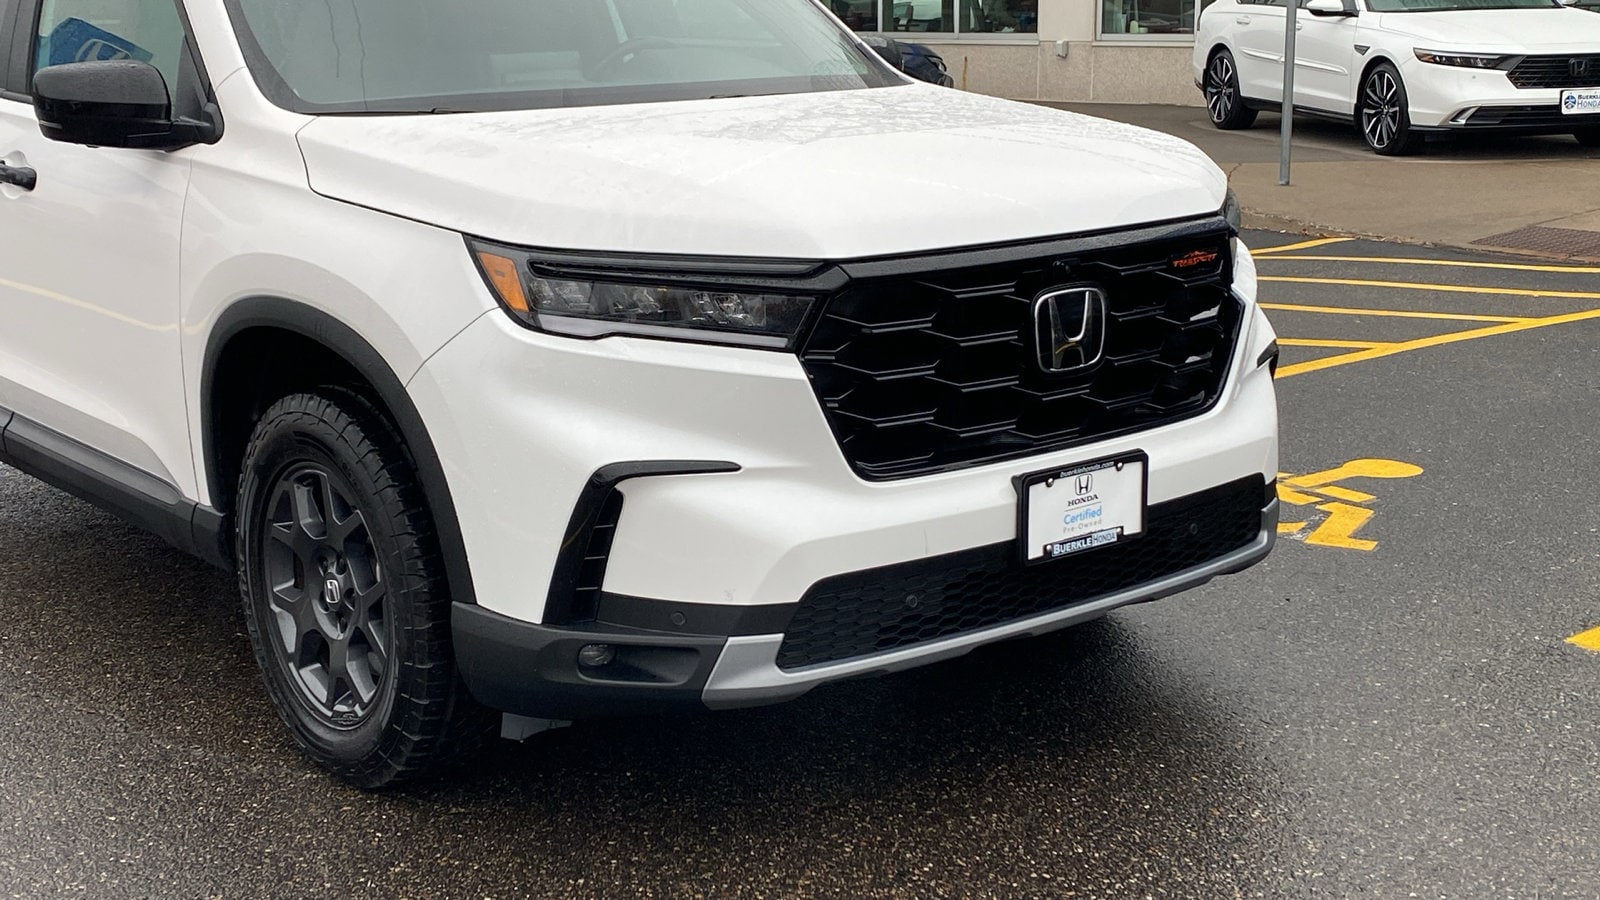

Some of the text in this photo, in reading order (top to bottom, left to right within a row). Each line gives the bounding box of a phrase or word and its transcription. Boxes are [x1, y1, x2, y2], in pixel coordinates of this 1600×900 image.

[1067, 494, 1099, 507] HONDA
[1063, 504, 1102, 525] Certified
[1063, 517, 1102, 533] Pre-Owned
